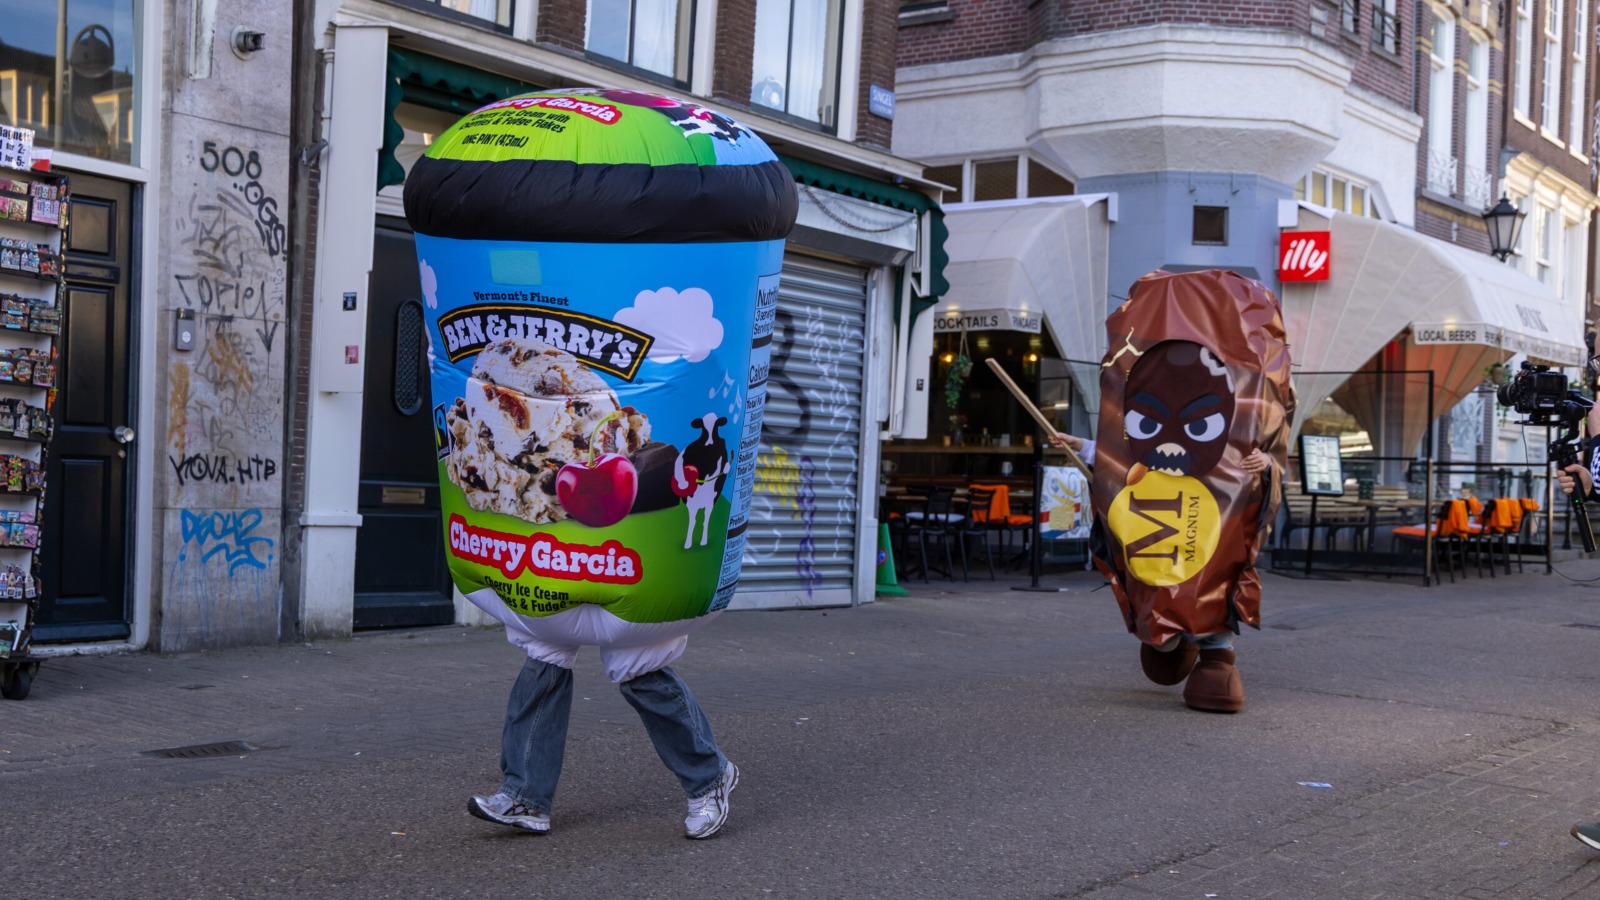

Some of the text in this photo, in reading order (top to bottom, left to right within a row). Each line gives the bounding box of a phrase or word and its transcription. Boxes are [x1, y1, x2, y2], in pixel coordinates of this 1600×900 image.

[515, 109, 544, 119] Cream
[546, 111, 571, 124] with
[545, 97, 616, 122] Garcia
[492, 116, 503, 125] &
[502, 116, 533, 127] Fudge
[531, 118, 566, 134] Flakes
[477, 133, 498, 146] PINT
[200, 141, 262, 179] 508
[1282, 238, 1328, 278] illy
[473, 291, 570, 306] Vermont's Finest
[1418, 330, 1446, 342] LOCAL
[1449, 330, 1476, 342] BEERS
[729, 515, 745, 527] Protein
[1126, 491, 1183, 566] M
[1185, 495, 1200, 562] MAGNUM
[450, 520, 635, 577] Cherry Garcia
[516, 582, 531, 597] Ice
[534, 585, 569, 601] Cream
[520, 597, 529, 610] &
[532, 599, 566, 612] Fudge
